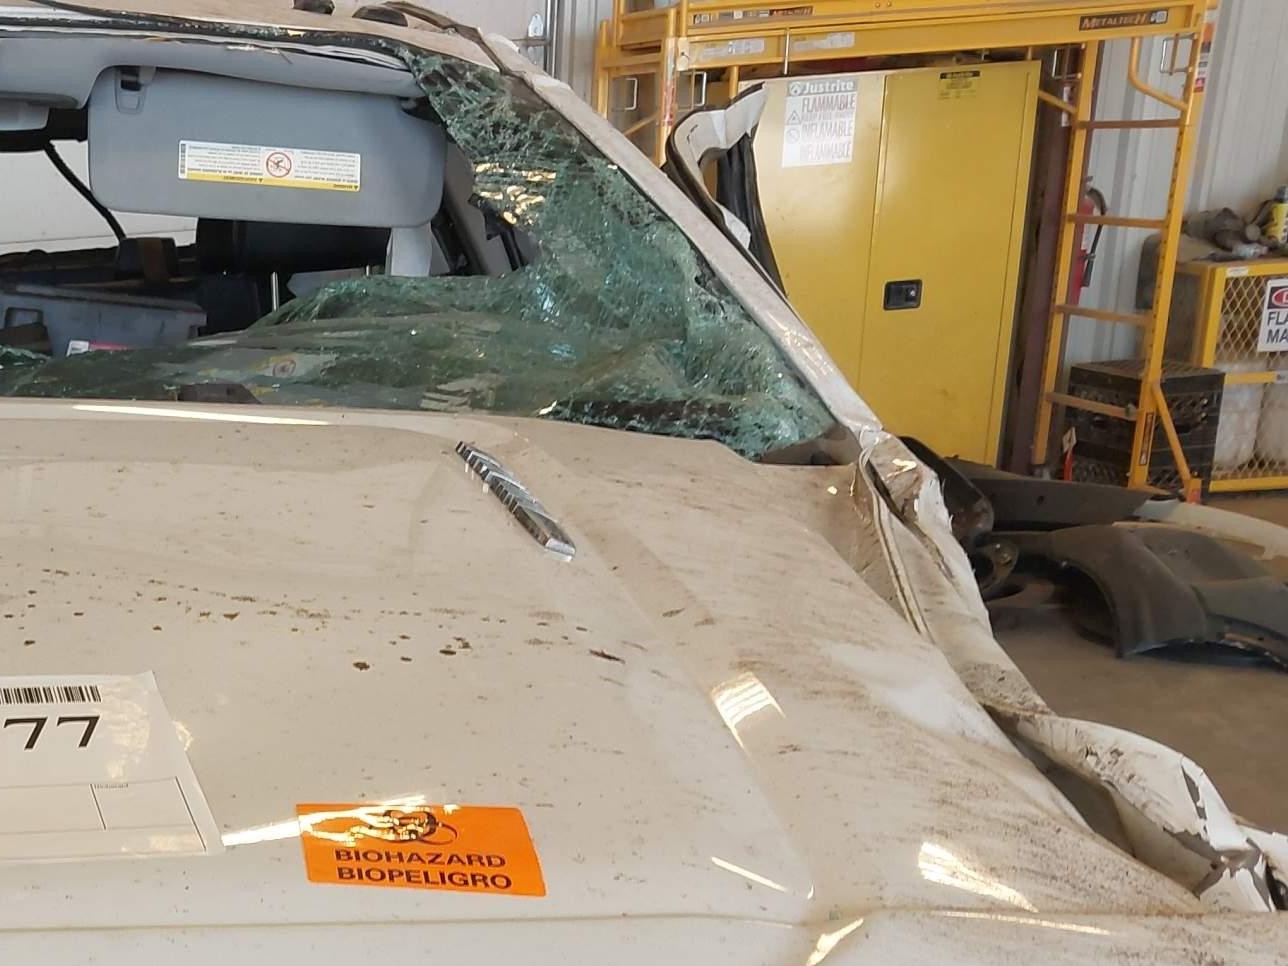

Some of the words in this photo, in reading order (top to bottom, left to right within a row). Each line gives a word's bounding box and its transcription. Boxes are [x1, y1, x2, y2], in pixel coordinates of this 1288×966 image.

[803, 79, 855, 94] Justrite
[801, 93, 856, 113] FLAMMABLE
[335, 847, 506, 868] BIOHAZARD
[337, 866, 513, 890] BIOPELIGRO
